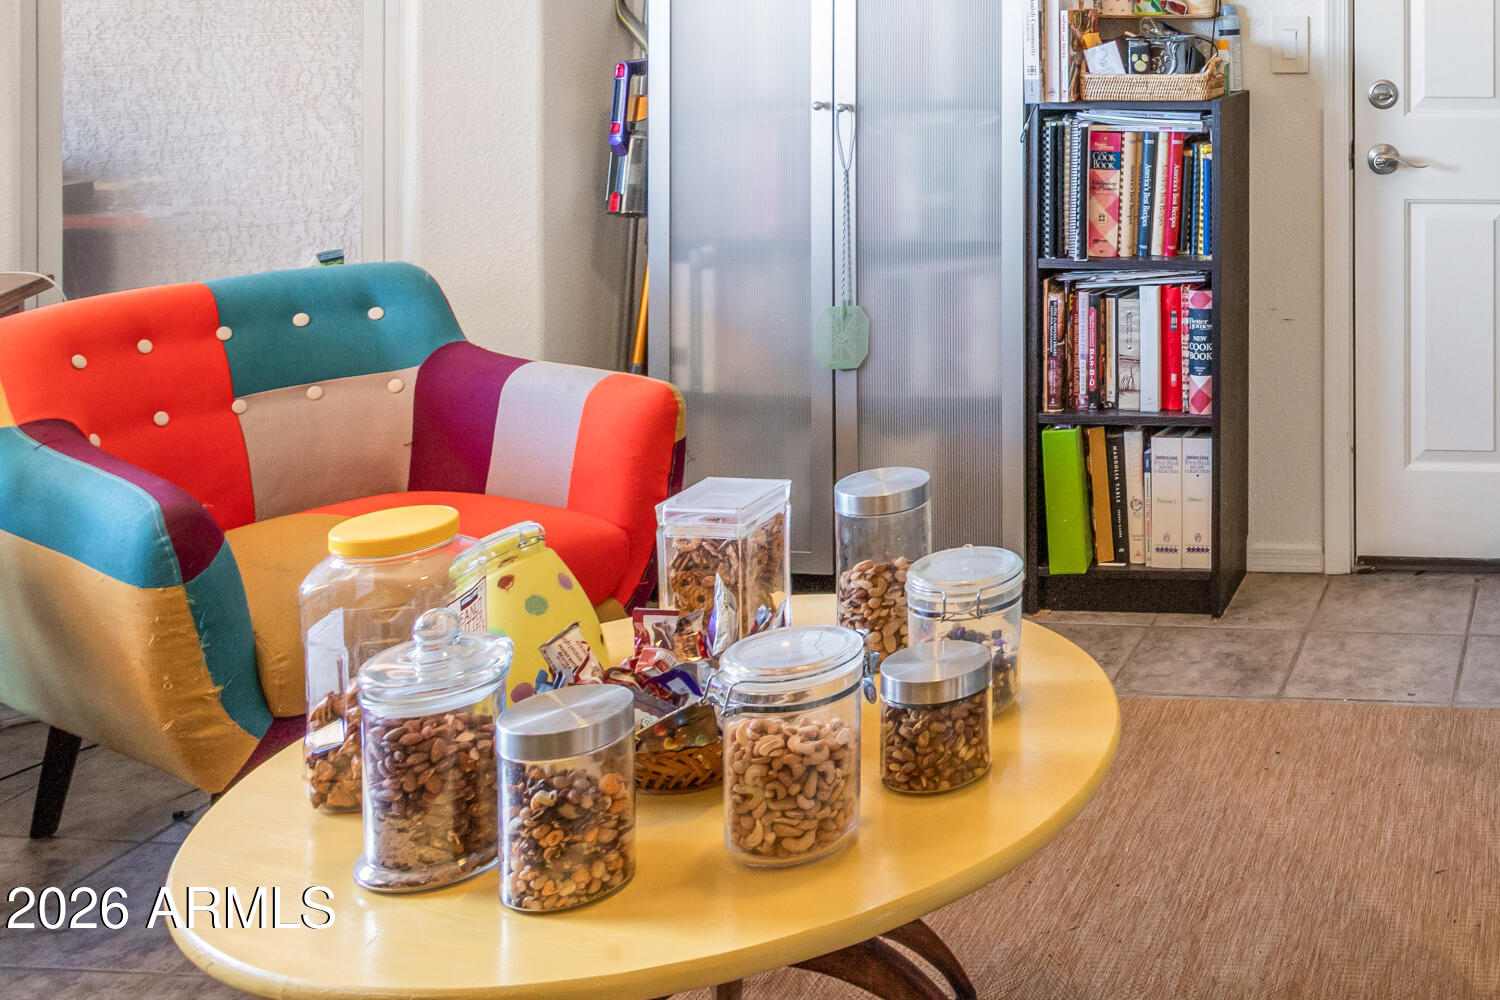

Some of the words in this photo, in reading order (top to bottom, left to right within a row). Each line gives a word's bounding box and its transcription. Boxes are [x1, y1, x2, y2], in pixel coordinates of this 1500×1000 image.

[1144, 163, 1152, 190] America's
[1172, 164, 1181, 192] America's
[1143, 192, 1151, 204] Best
[1141, 205, 1150, 227] Recipes
[1169, 206, 1178, 228] Recipes
[1189, 343, 1213, 351] COOK
[1189, 352, 1213, 361] BOOK
[1112, 445, 1120, 480] MAGNOLIA
[460, 597, 483, 624] EANUT
